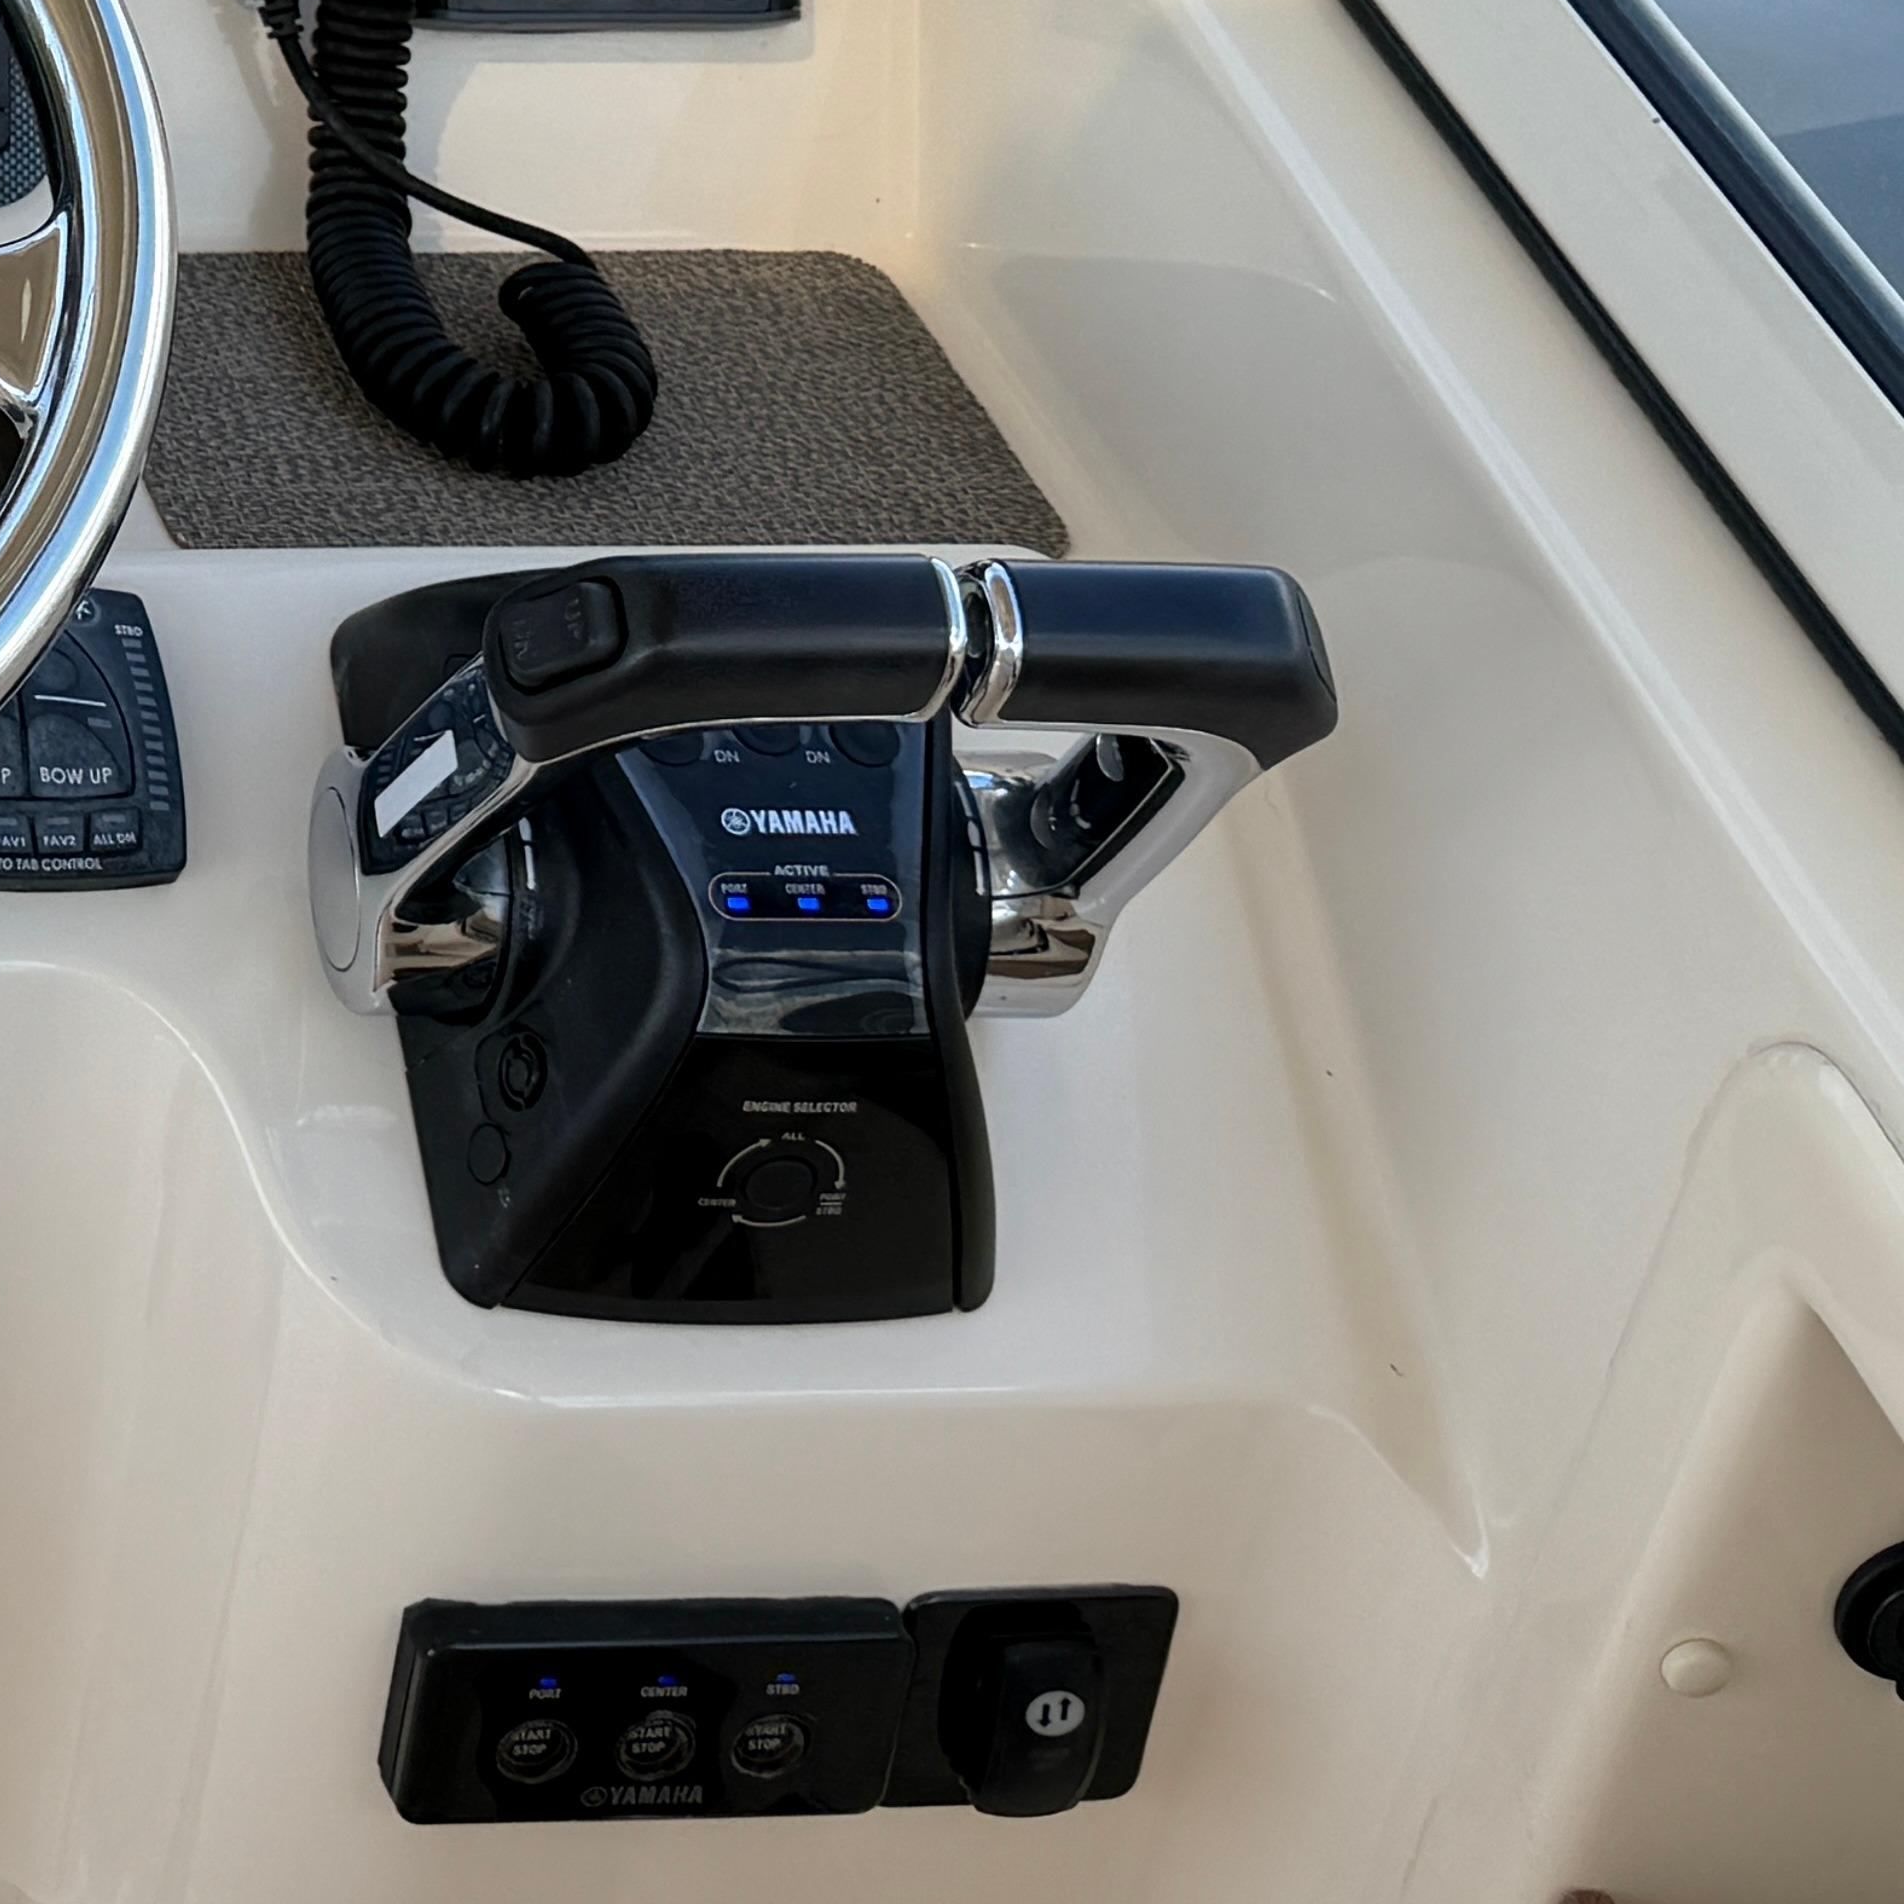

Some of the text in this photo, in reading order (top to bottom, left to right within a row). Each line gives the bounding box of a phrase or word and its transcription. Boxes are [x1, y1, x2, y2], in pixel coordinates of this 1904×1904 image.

[114, 625, 143, 637] STBD
[713, 749, 741, 764] DN
[805, 749, 831, 765] DN
[39, 767, 113, 784] BOW UP
[748, 809, 860, 836] YAMAHA
[43, 833, 76, 846] FAV2
[93, 833, 115, 845] ALL
[16, 858, 39, 871] TAB
[41, 858, 103, 872] CONTROL
[774, 864, 830, 877] ACTIVE
[792, 1101, 858, 1114] SELECTOR
[528, 1687, 562, 1700] PORT
[640, 1686, 688, 1698] CENTER
[766, 1683, 800, 1696] STBD
[625, 1726, 672, 1740] START
[512, 1742, 548, 1756] STOP
[631, 1740, 667, 1754] STOP
[748, 1738, 783, 1751] STOP
[610, 1785, 703, 1805] YAMAHA
